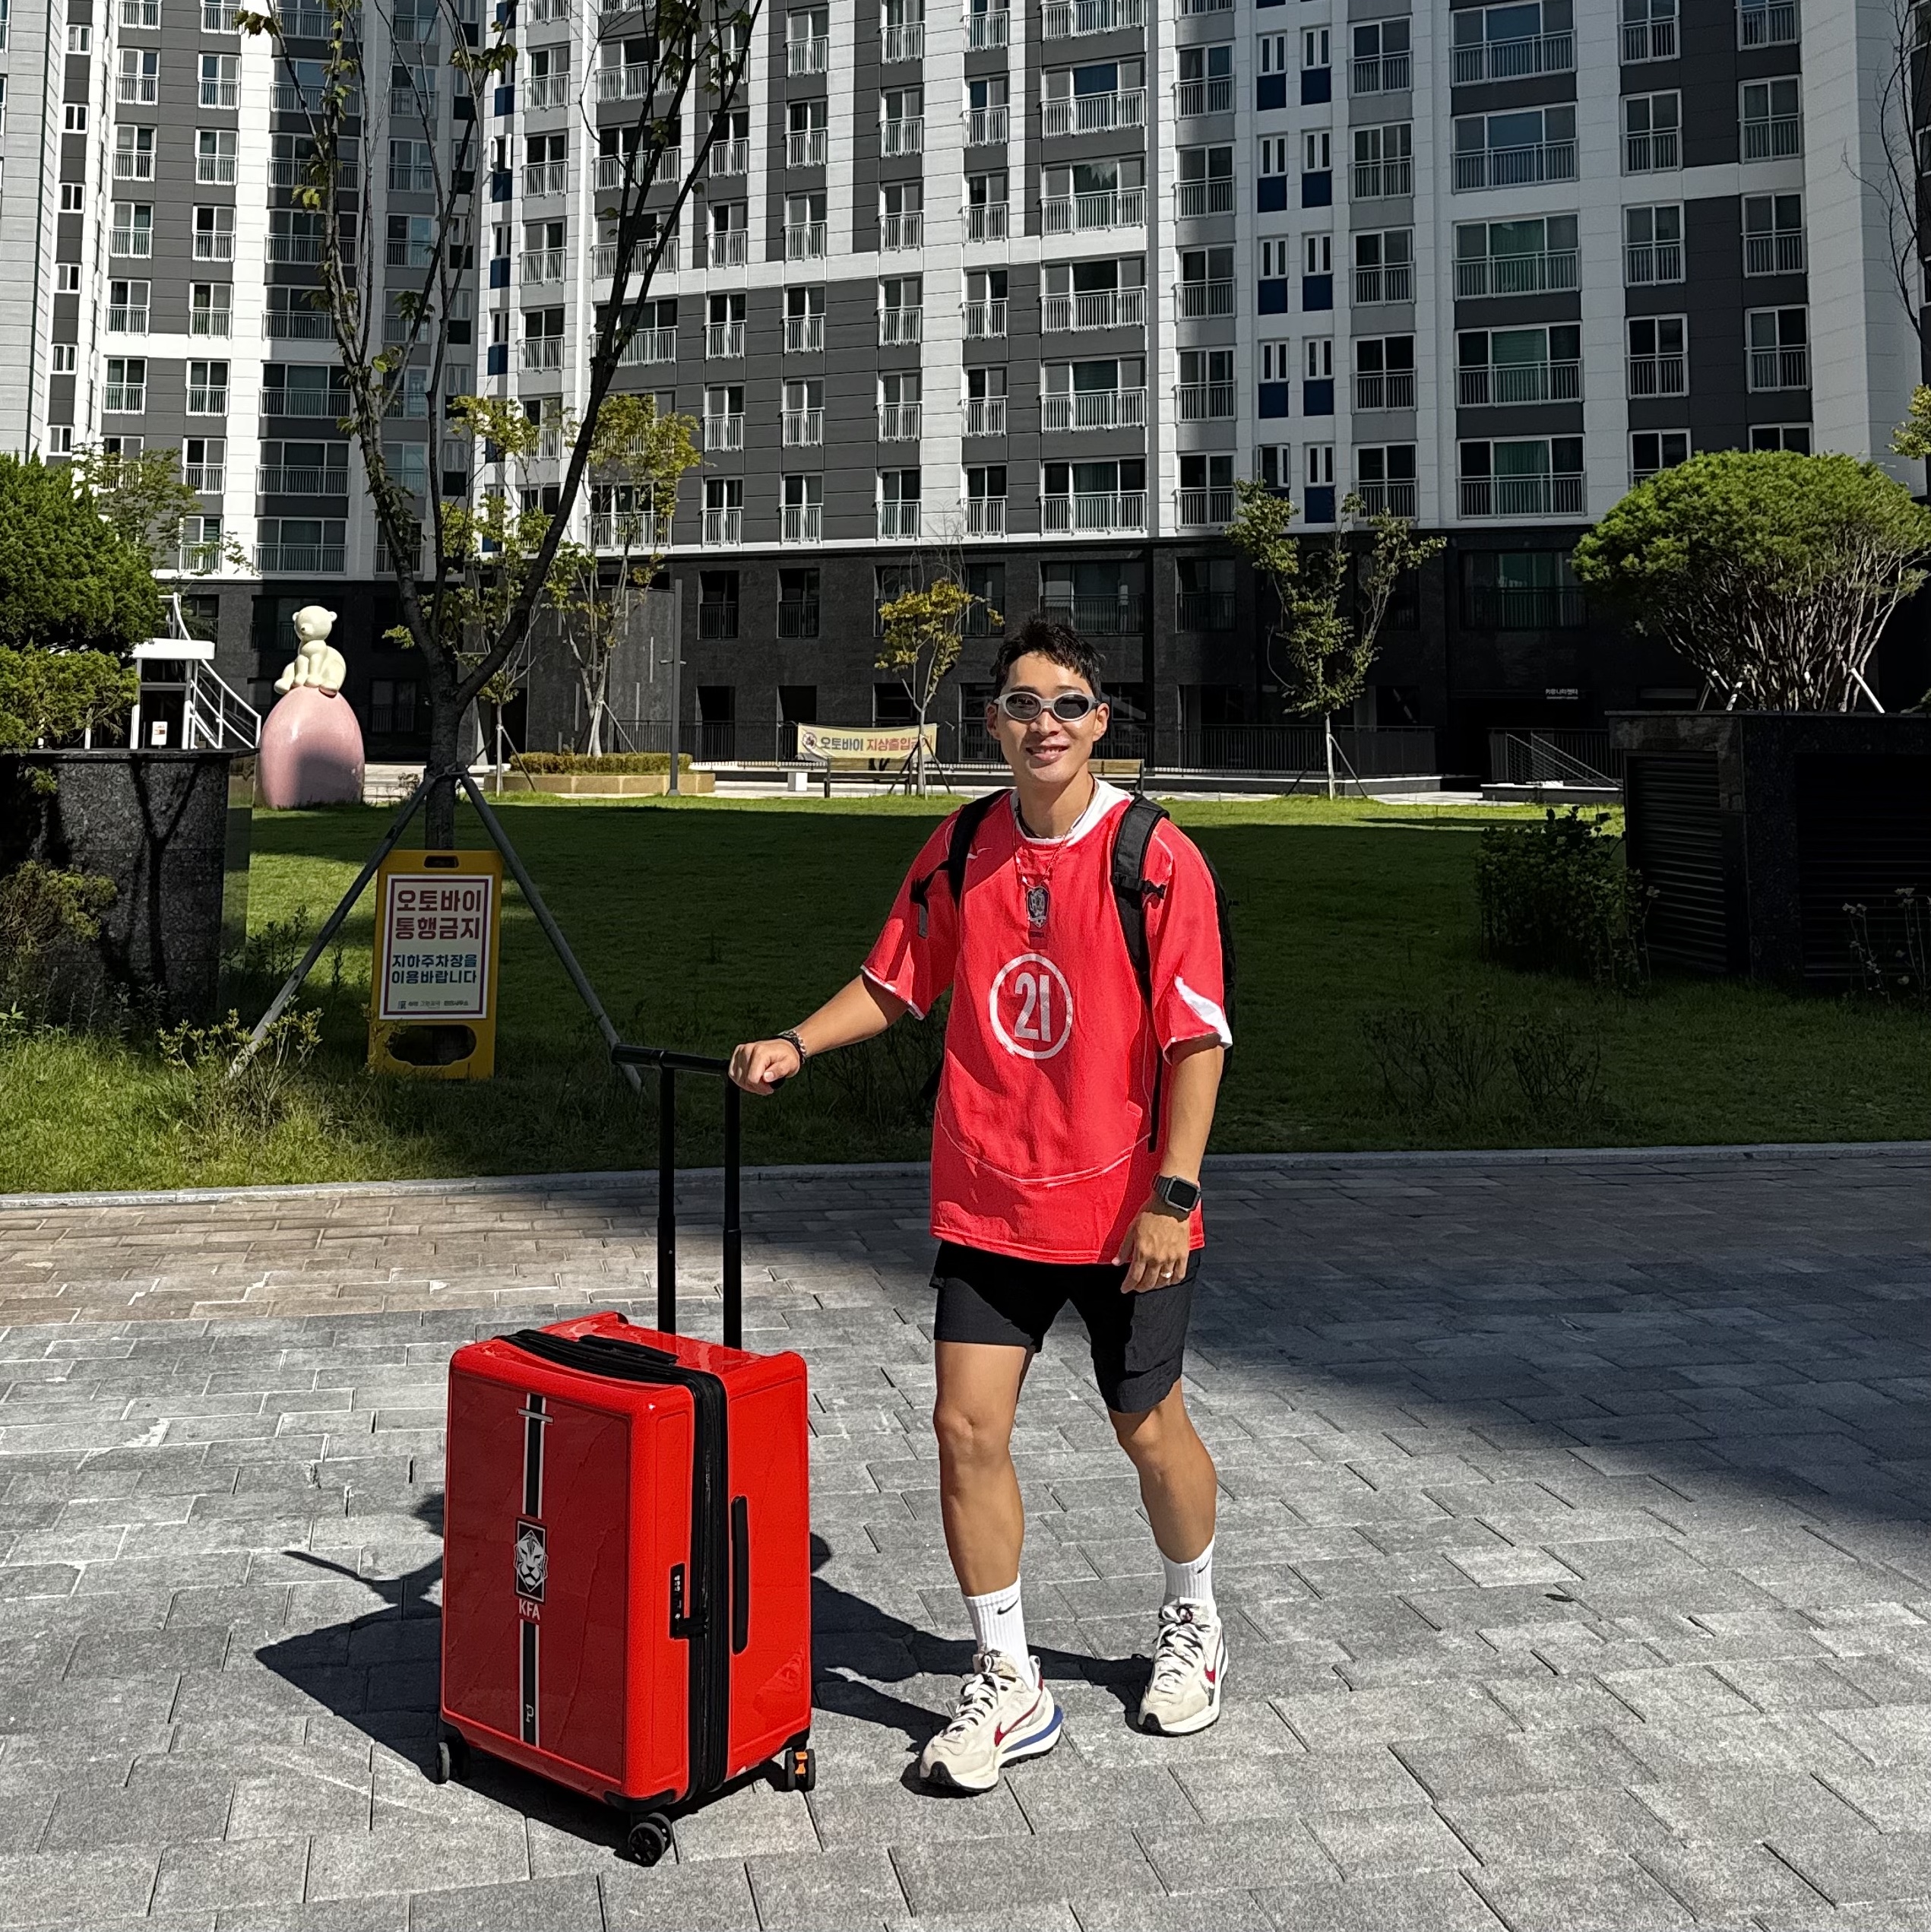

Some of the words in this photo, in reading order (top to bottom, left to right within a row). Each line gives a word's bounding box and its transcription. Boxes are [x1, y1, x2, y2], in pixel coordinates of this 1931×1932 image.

[820, 736, 863, 752] 오토바이
[397, 889, 481, 912] 오토바이
[395, 917, 480, 939] 통행금지
[392, 954, 477, 968] 지하주차장을
[391, 970, 477, 984] 이용바랍니다
[1013, 972, 1052, 1043] 21
[518, 1598, 541, 1620] KFA
